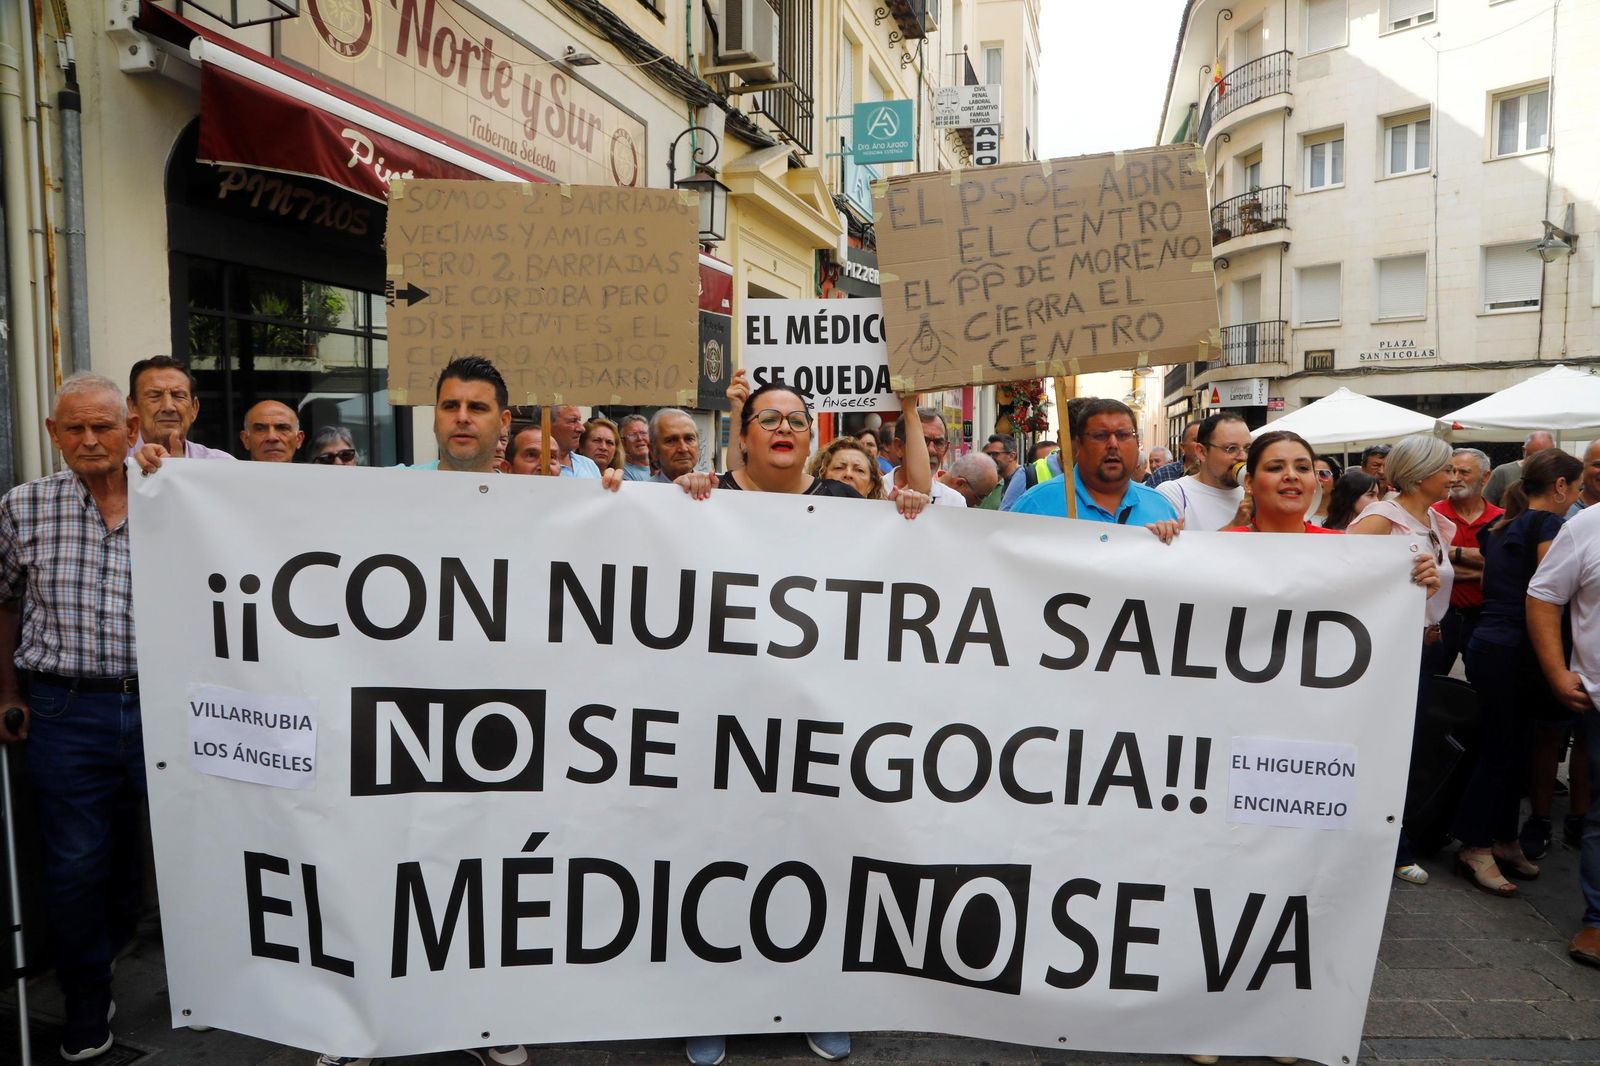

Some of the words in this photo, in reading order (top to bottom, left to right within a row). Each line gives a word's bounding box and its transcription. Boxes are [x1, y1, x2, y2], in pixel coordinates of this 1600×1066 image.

[388, 0, 513, 108] Norte
[521, 71, 543, 141] y
[544, 73, 602, 154] Sur
[469, 114, 518, 154] Taberna
[520, 139, 557, 174] Selecta
[405, 185, 507, 214] SOMOS
[887, 186, 944, 231] EL
[1097, 153, 1204, 205] ABRE
[542, 224, 649, 248] AMIGAS
[957, 225, 1012, 265] EL
[1026, 200, 1184, 253] CENTRO
[526, 250, 684, 284] BARRIADAS
[903, 279, 945, 312] EL
[957, 270, 1006, 307] PP
[1015, 255, 1057, 288] DE
[1068, 235, 1203, 281] MORENO
[420, 284, 461, 309] DE
[470, 284, 593, 310] CORDOBA
[601, 283, 670, 309] PERO
[1098, 276, 1146, 306] EL
[632, 315, 672, 339] EL
[746, 315, 778, 345] EL
[987, 311, 1164, 372] CENTRO
[1360, 352, 1380, 361] SAN
[1383, 349, 1436, 359] NICOLAS
[1379, 339, 1415, 349] PLAZA
[575, 364, 680, 392] BARRIO
[793, 364, 893, 400] QUEDA
[547, 560, 1011, 667] NUESTRA
[1038, 591, 1373, 690] SALUD
[190, 701, 313, 732] VILLARRUBIA
[193, 740, 229, 759] LOS
[232, 742, 314, 773] ÁNGELES
[374, 699, 535, 787] NO
[565, 702, 681, 790] SE
[713, 714, 1213, 815] NEGOCIA!!
[1231, 754, 1251, 770] EL
[1256, 756, 1356, 778] HIGUERÓN
[1233, 795, 1348, 817] ENCINAREJO
[243, 849, 356, 979] EL
[390, 831, 828, 979] MÉDICO
[858, 869, 1018, 983] NO
[1043, 877, 1167, 993] SE
[1192, 886, 1313, 993] VA
